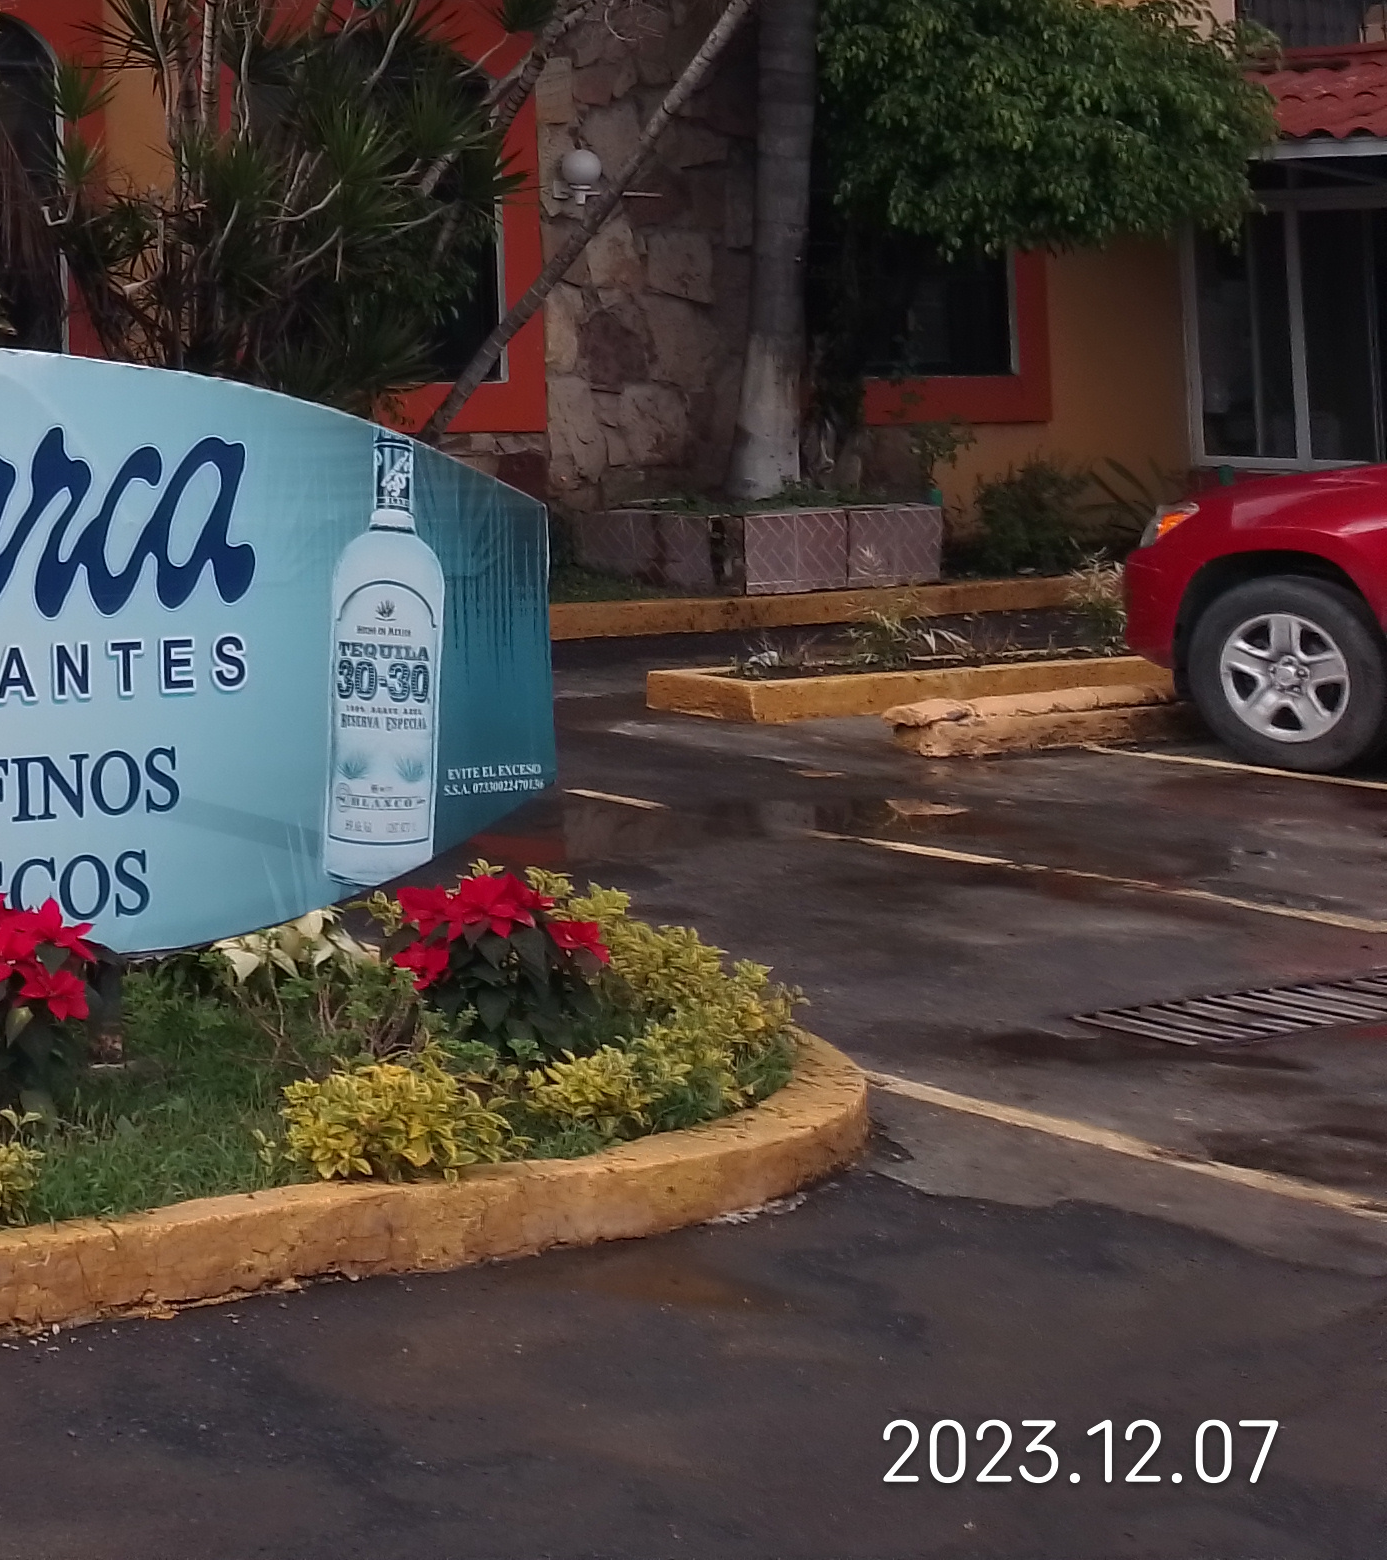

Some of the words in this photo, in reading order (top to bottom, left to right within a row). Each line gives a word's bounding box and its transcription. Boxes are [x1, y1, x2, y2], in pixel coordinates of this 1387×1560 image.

[338, 641, 429, 662] TEQUILA
[337, 658, 430, 703] 30-30
[340, 713, 380, 729] RESERVA
[385, 716, 427, 731] ESPECIAL
[447, 767, 480, 780] EVITE
[482, 765, 497, 777] EL
[498, 763, 542, 777] EXCESO
[350, 797, 413, 808] BLANCO
